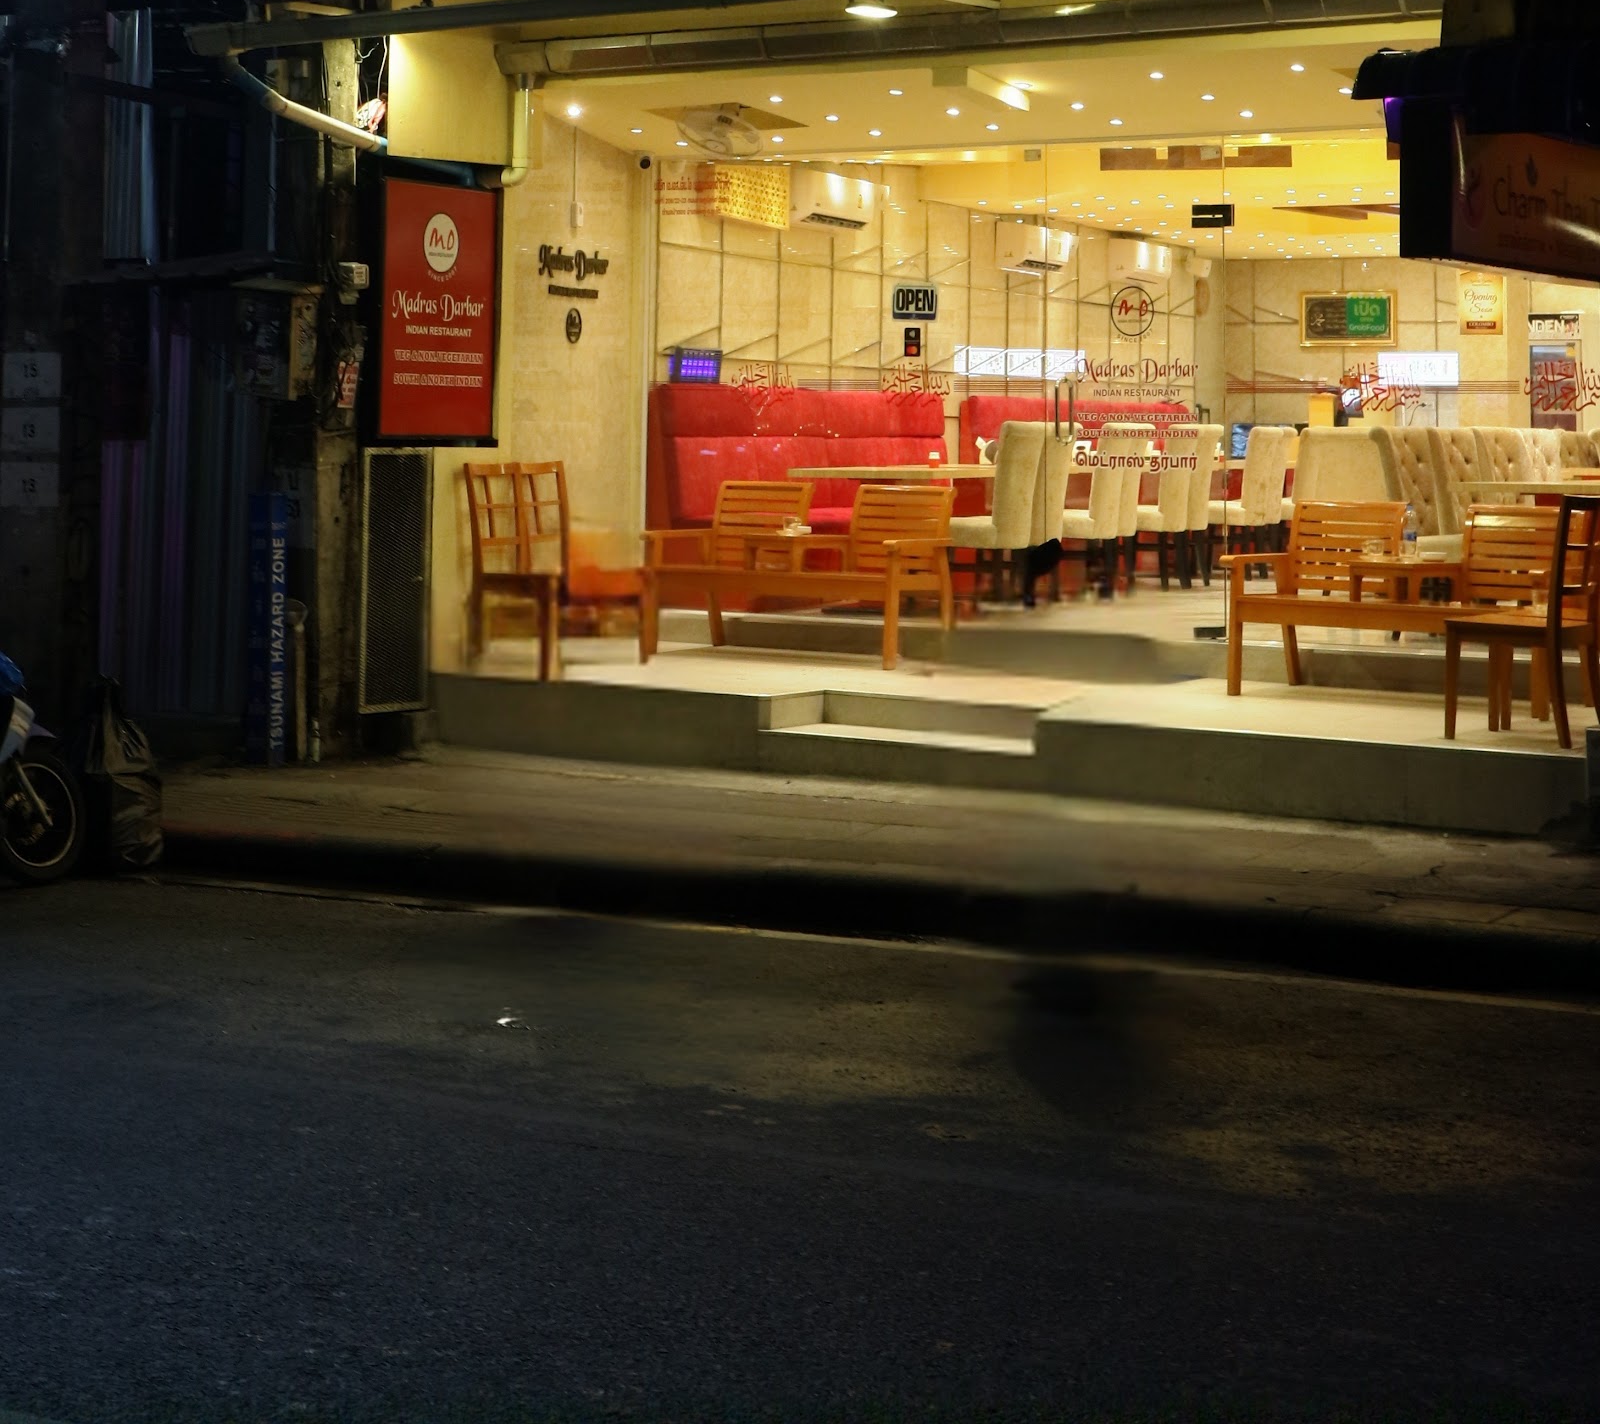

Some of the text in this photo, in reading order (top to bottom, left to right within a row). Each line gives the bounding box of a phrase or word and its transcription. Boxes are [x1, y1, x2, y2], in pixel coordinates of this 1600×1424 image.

[895, 288, 934, 312] OPEN
[1463, 288, 1498, 305] Opening
[392, 289, 484, 322] Madras Darbar
[405, 324, 472, 338] INDIAN RESTAURANT
[1348, 323, 1385, 332] GrabFood
[1076, 357, 1199, 383] Madras Darbar
[393, 372, 420, 386] SOUTH
[1093, 388, 1181, 398] INDIAN RESTAURANT
[1077, 413, 1199, 423] VEG & NON-VEGETARIAN
[1077, 428, 1199, 439] SOUTH & NORTH INDIAN
[1075, 450, 1198, 473] மெட்ராஸ் தர்பார்
[269, 536, 286, 751] TSUNAMI HAZARD ZONE
